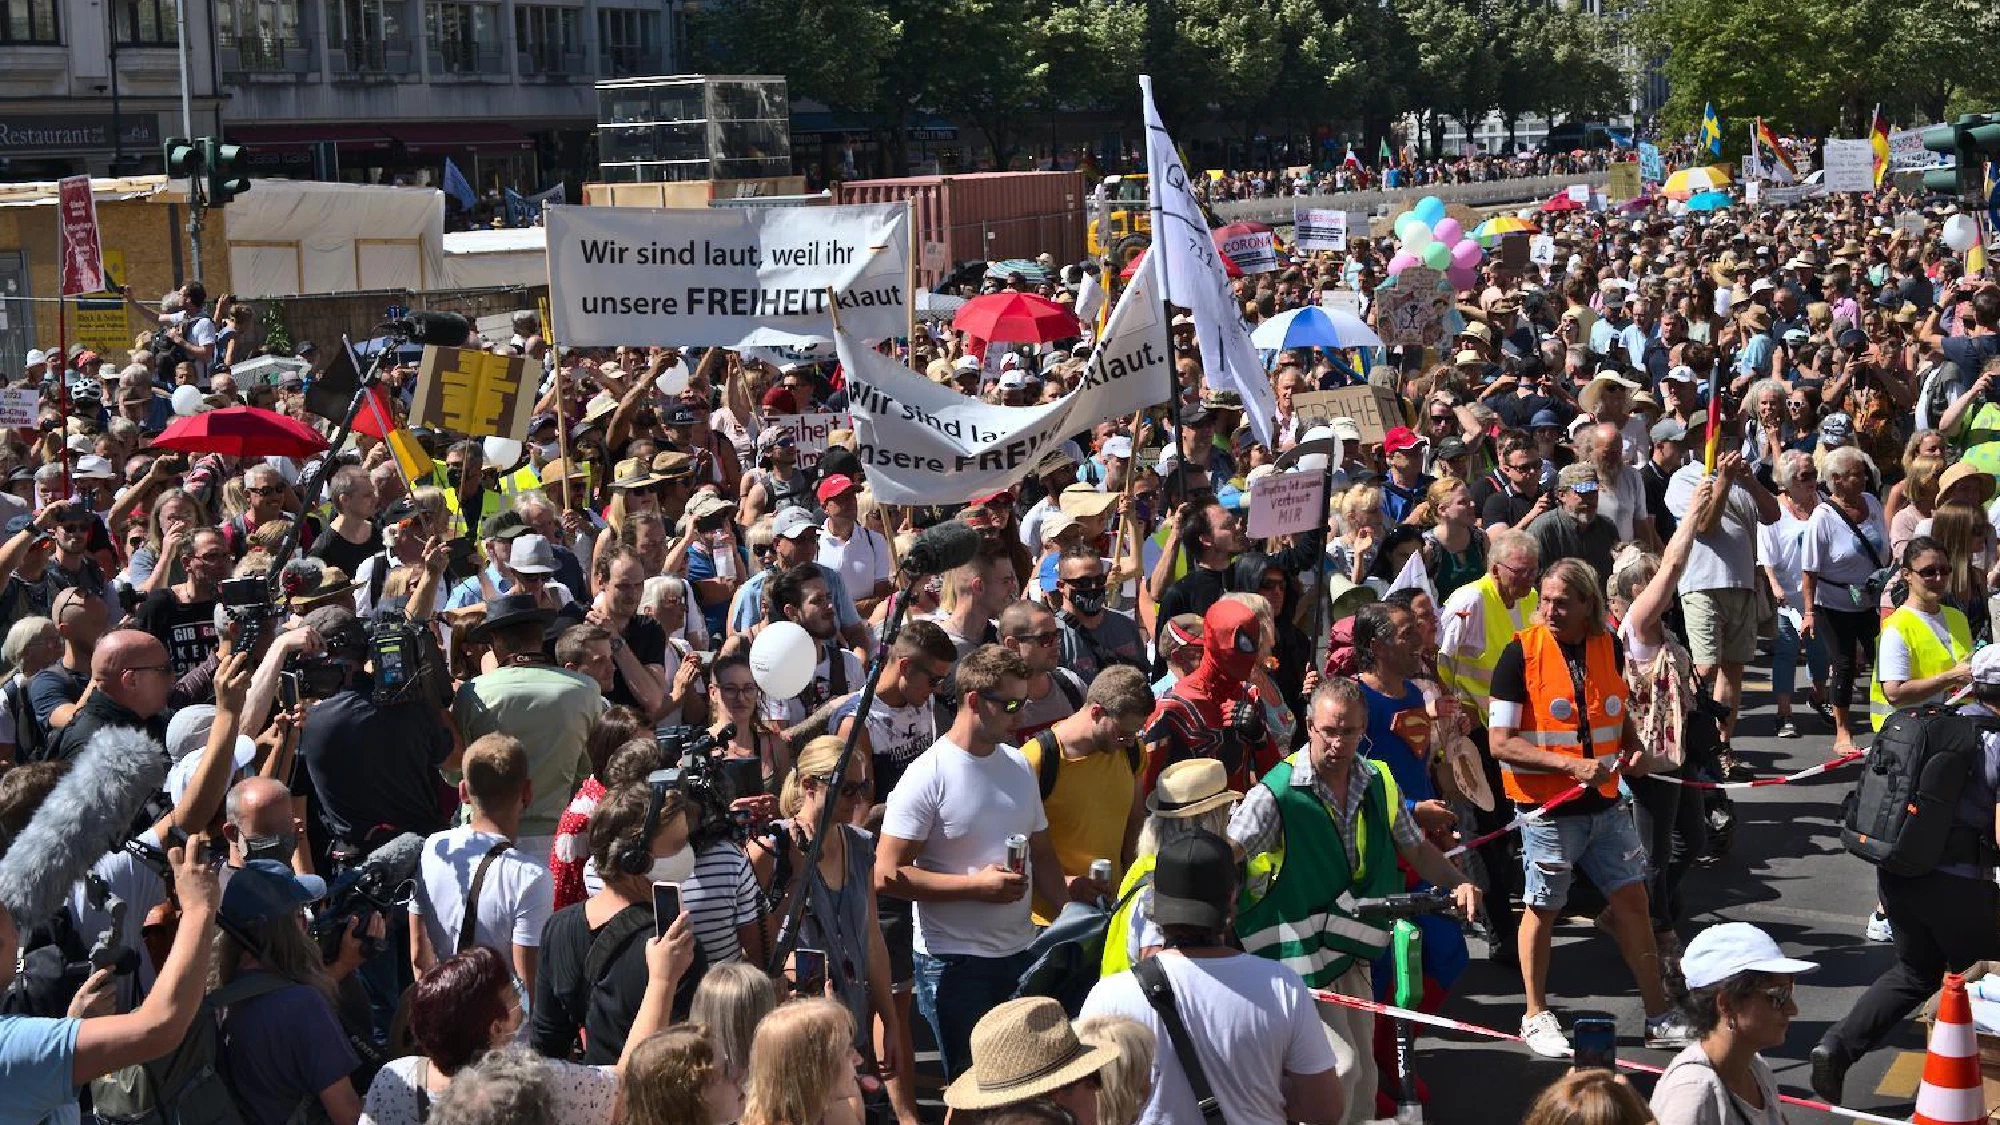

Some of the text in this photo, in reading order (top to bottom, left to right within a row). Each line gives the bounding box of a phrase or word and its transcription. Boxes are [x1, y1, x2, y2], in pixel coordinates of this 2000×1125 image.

[580, 239, 854, 270] Wir sind laut, weil ihr
[581, 294, 678, 315] unsere
[687, 286, 826, 316] FREIHEIT
[901, 403, 962, 440] sind
[858, 441, 945, 473] nsere
[1278, 508, 1303, 525] MIR
[173, 627, 197, 642] GIB
